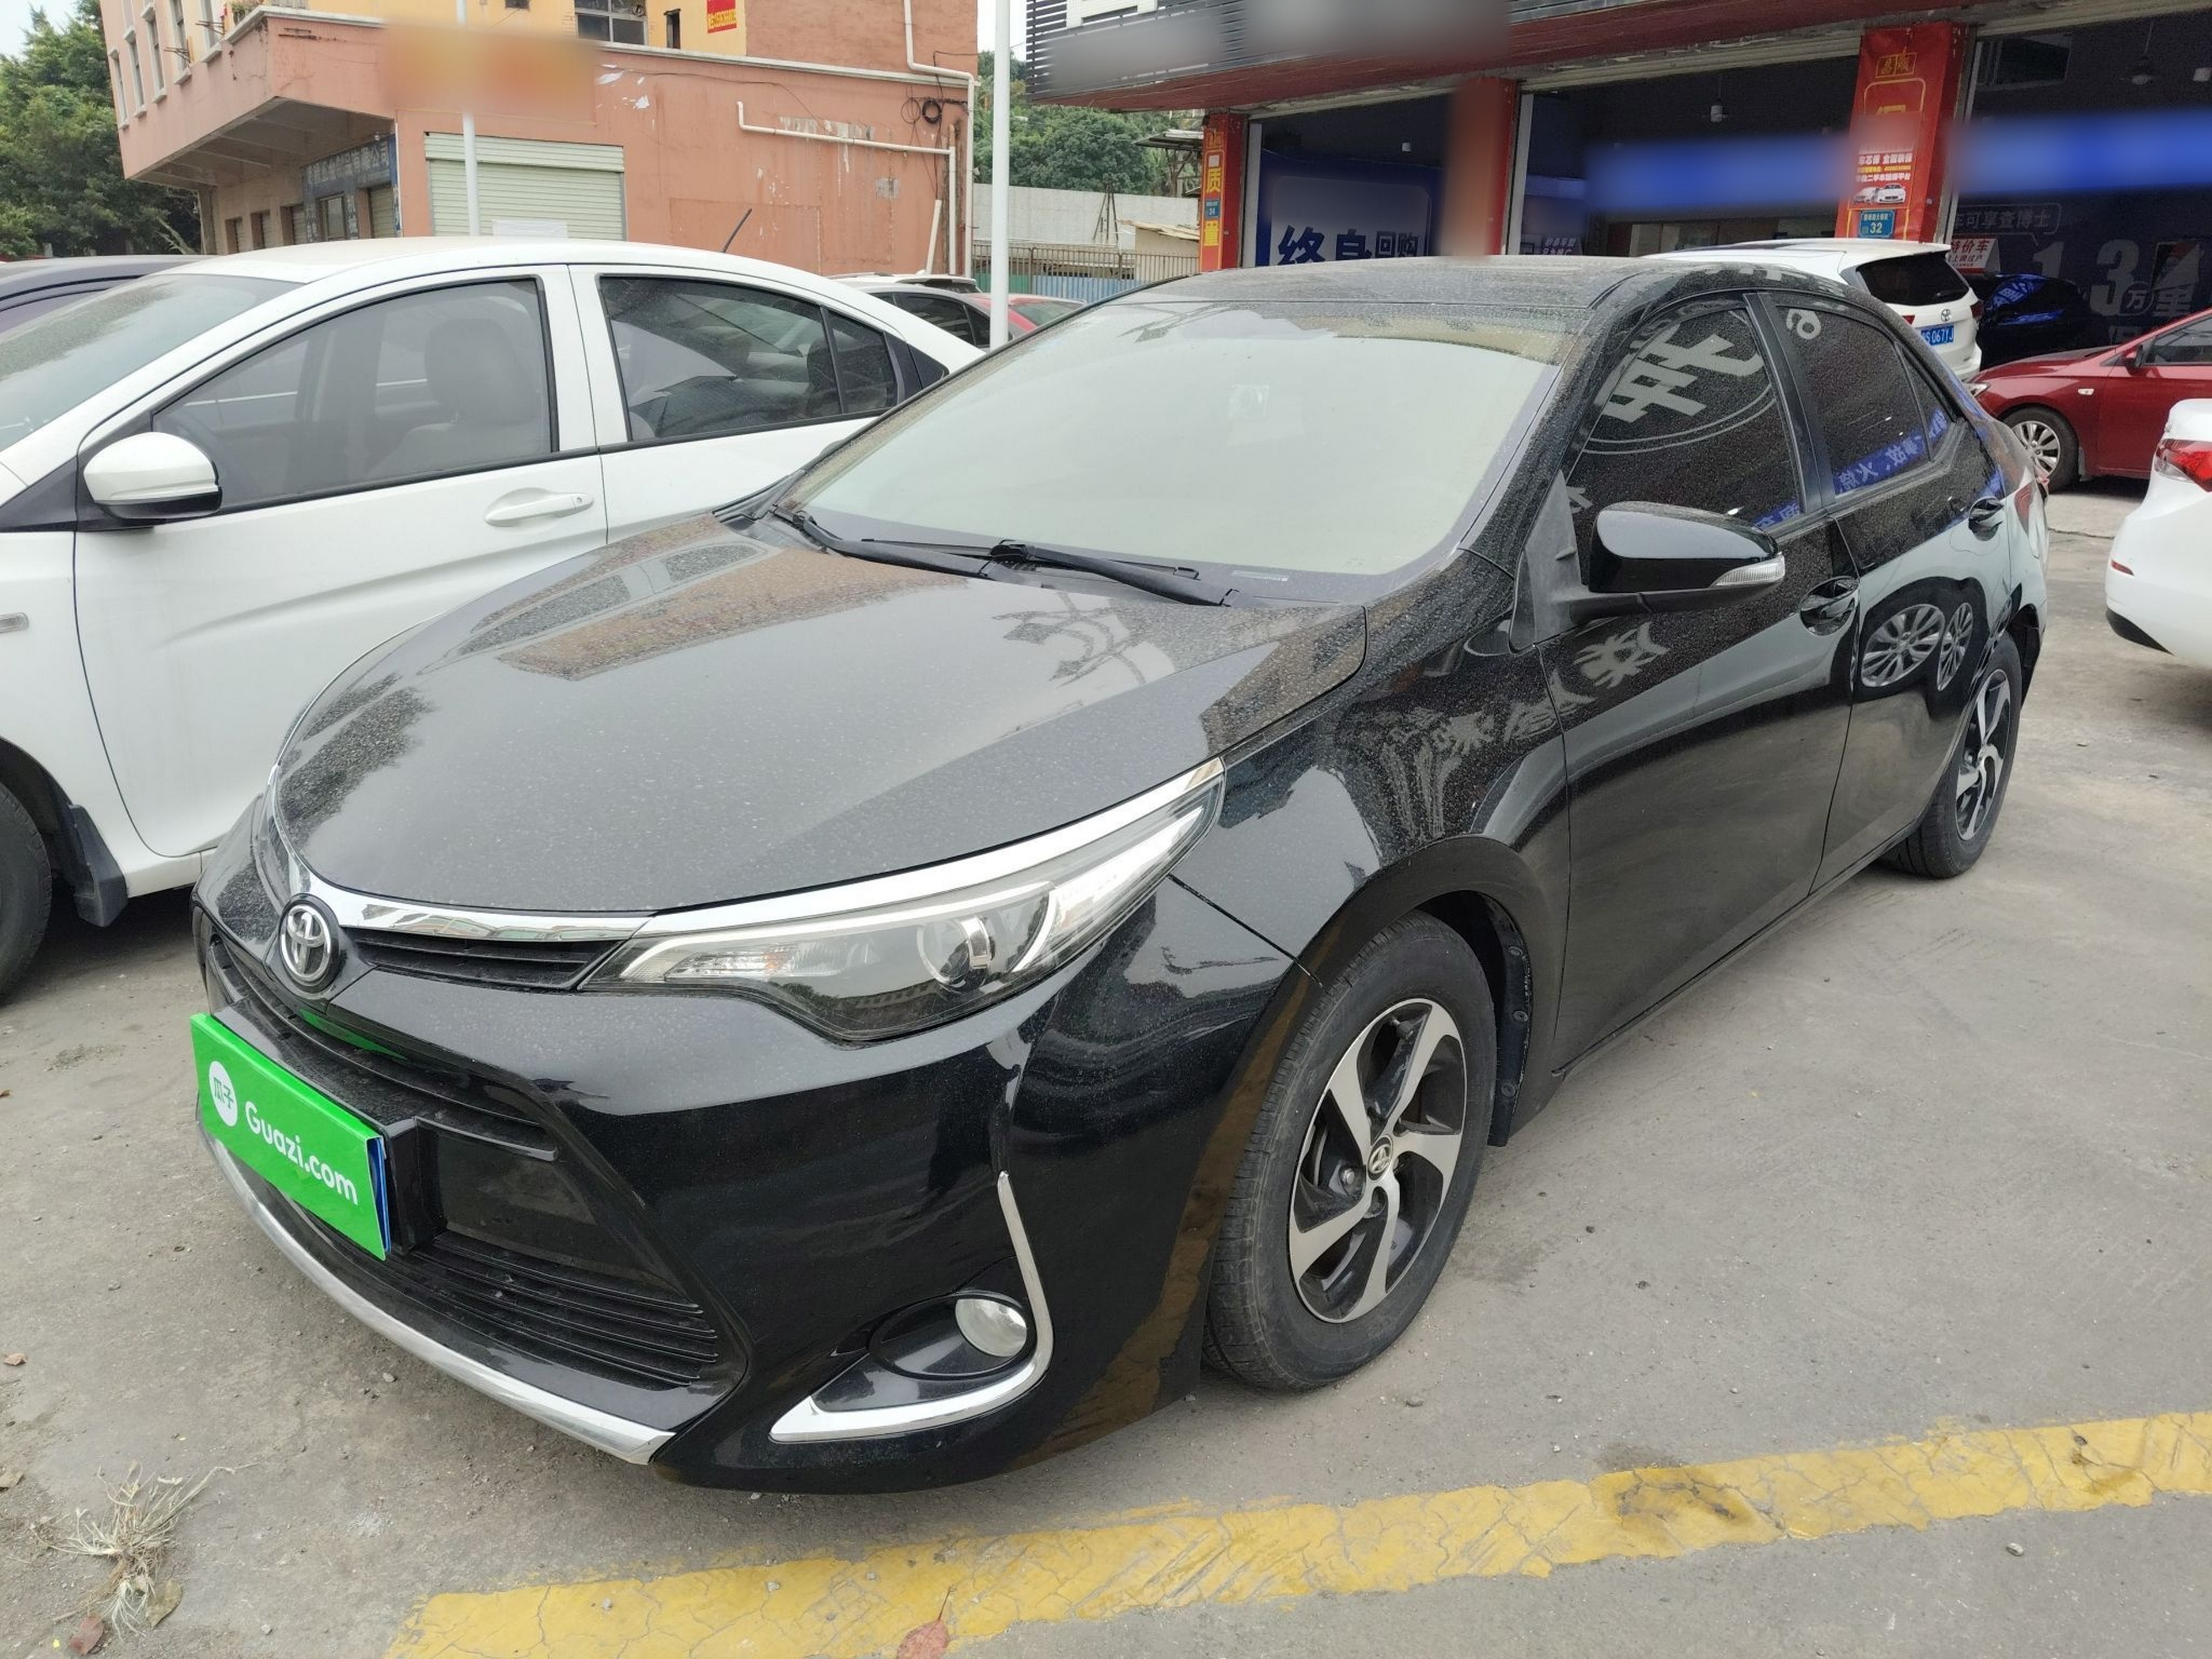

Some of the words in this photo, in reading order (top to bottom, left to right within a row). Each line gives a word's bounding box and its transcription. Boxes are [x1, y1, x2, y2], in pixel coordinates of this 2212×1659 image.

[1870, 222, 1883, 234] 32
[1922, 327, 1953, 344] S067YJ
[213, 1076, 234, 1109] 瓜子
[245, 1101, 358, 1206] Guazi.com
